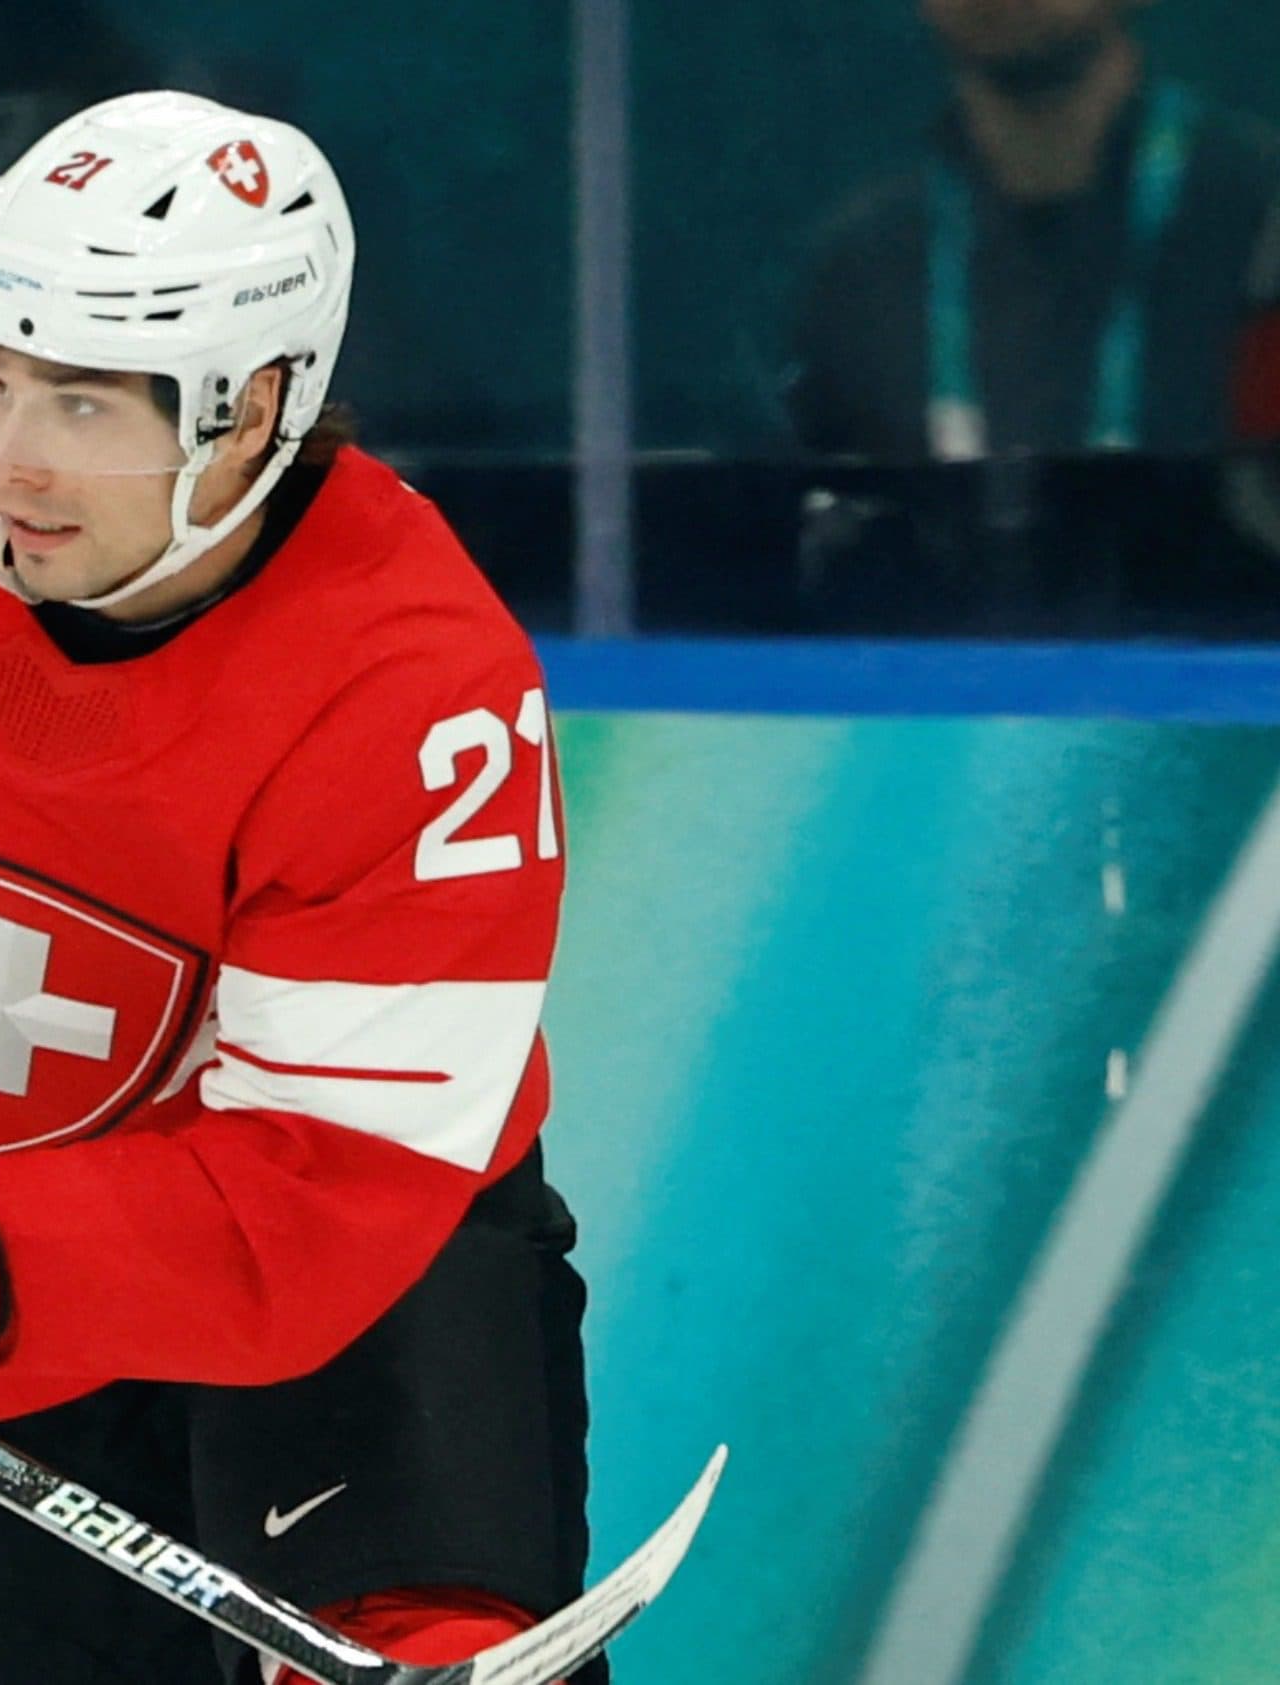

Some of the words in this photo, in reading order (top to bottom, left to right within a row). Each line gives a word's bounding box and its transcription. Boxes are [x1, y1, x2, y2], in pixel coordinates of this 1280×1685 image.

[45, 152, 113, 192] 21
[232, 271, 307, 307] BAUER
[414, 687, 559, 882] 21
[34, 1481, 244, 1609] BAUER
